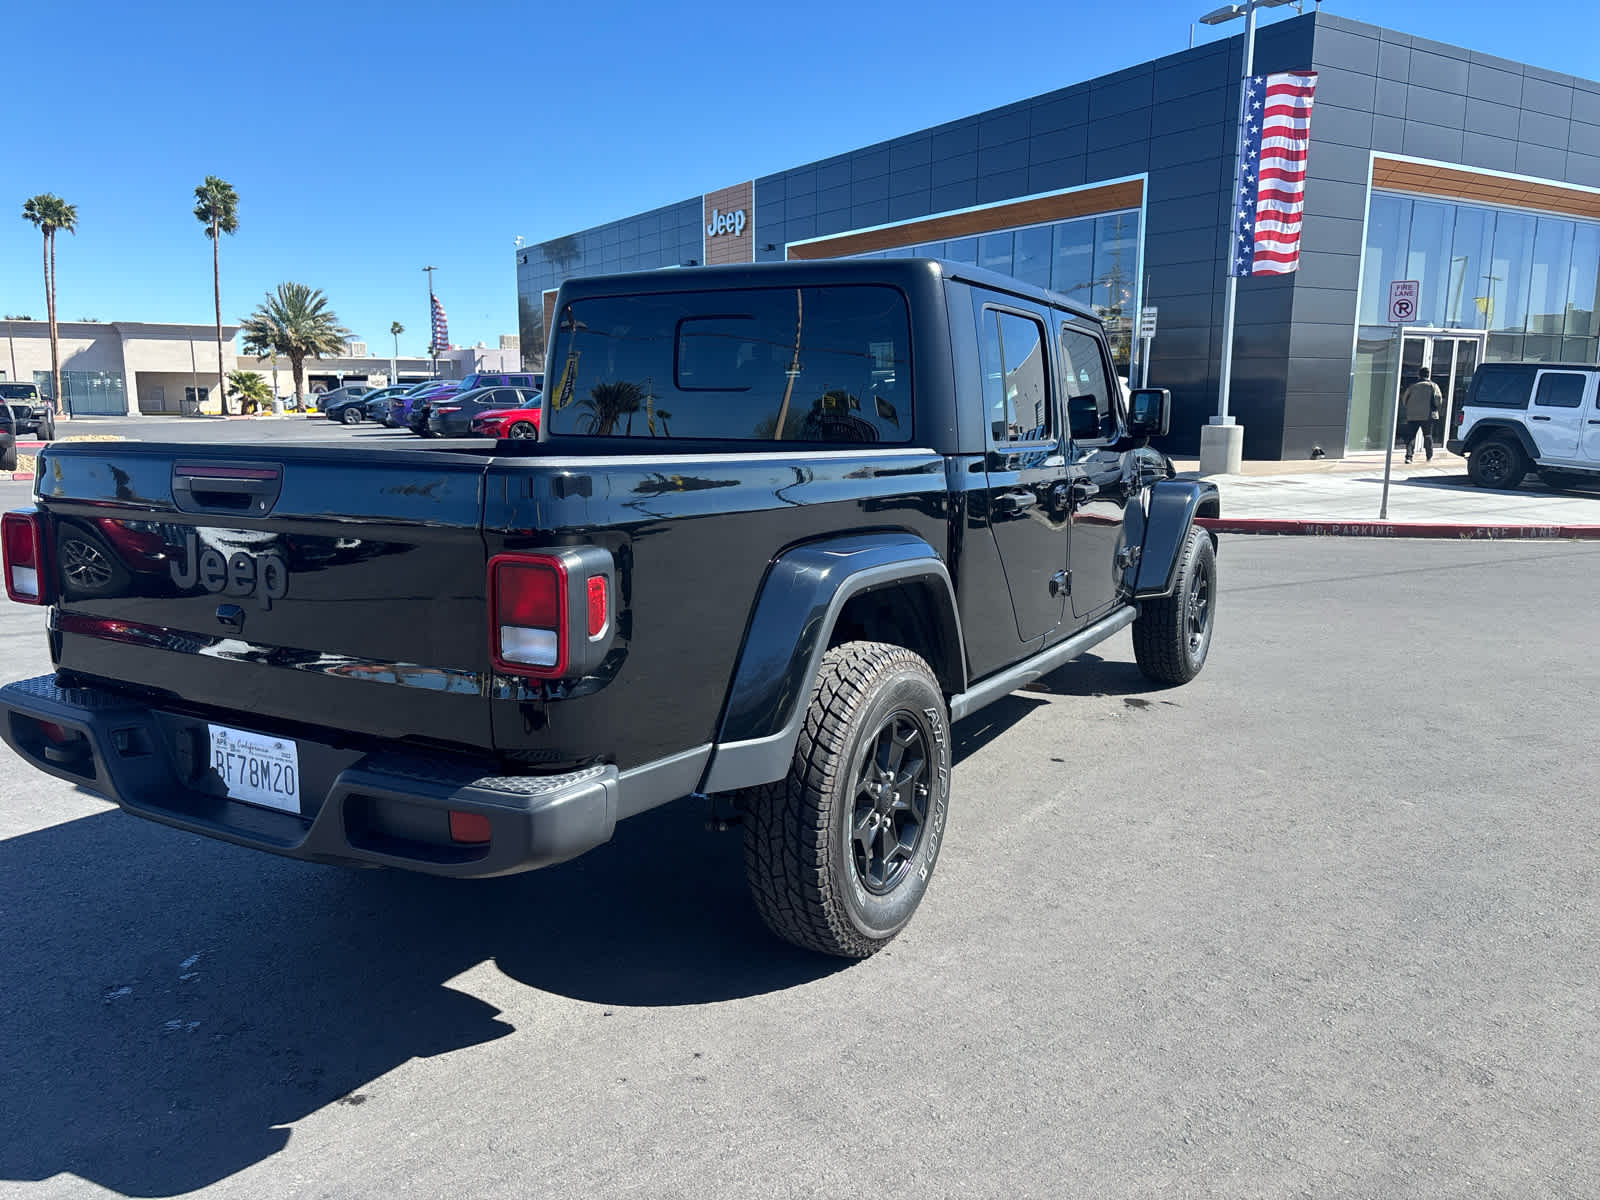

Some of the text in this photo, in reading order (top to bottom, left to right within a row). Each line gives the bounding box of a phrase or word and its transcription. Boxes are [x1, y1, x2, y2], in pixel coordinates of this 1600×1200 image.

[707, 208, 746, 237] Jeep
[1332, 524, 1393, 537] PARKING
[1476, 527, 1557, 538] FIRE LANE
[169, 533, 288, 612] Jeep
[216, 749, 295, 796] BF78M20
